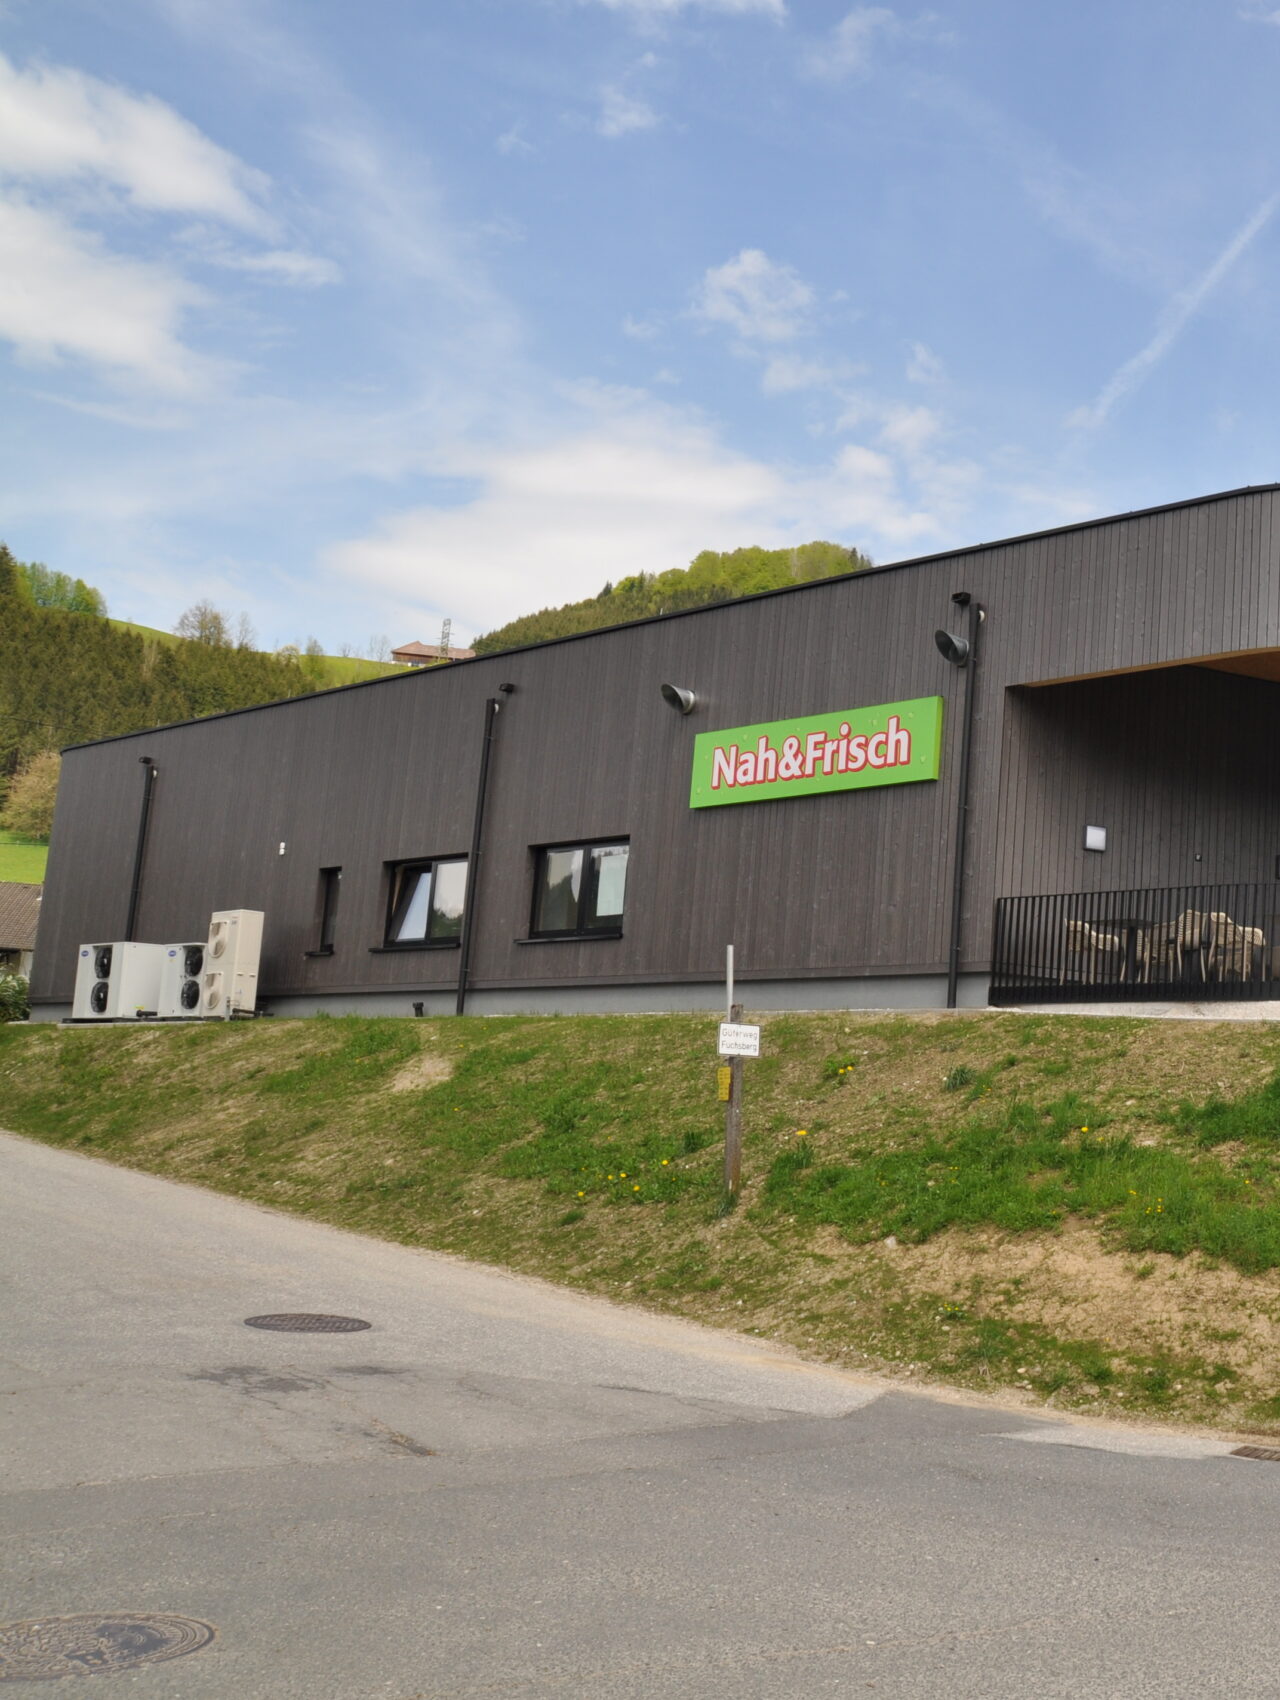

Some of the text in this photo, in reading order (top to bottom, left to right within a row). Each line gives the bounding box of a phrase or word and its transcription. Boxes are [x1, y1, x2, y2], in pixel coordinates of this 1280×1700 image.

[710, 714, 912, 790] Nah&Frisch
[721, 1028, 758, 1040] Güterweg
[721, 1040, 758, 1053] Fuchsberg
